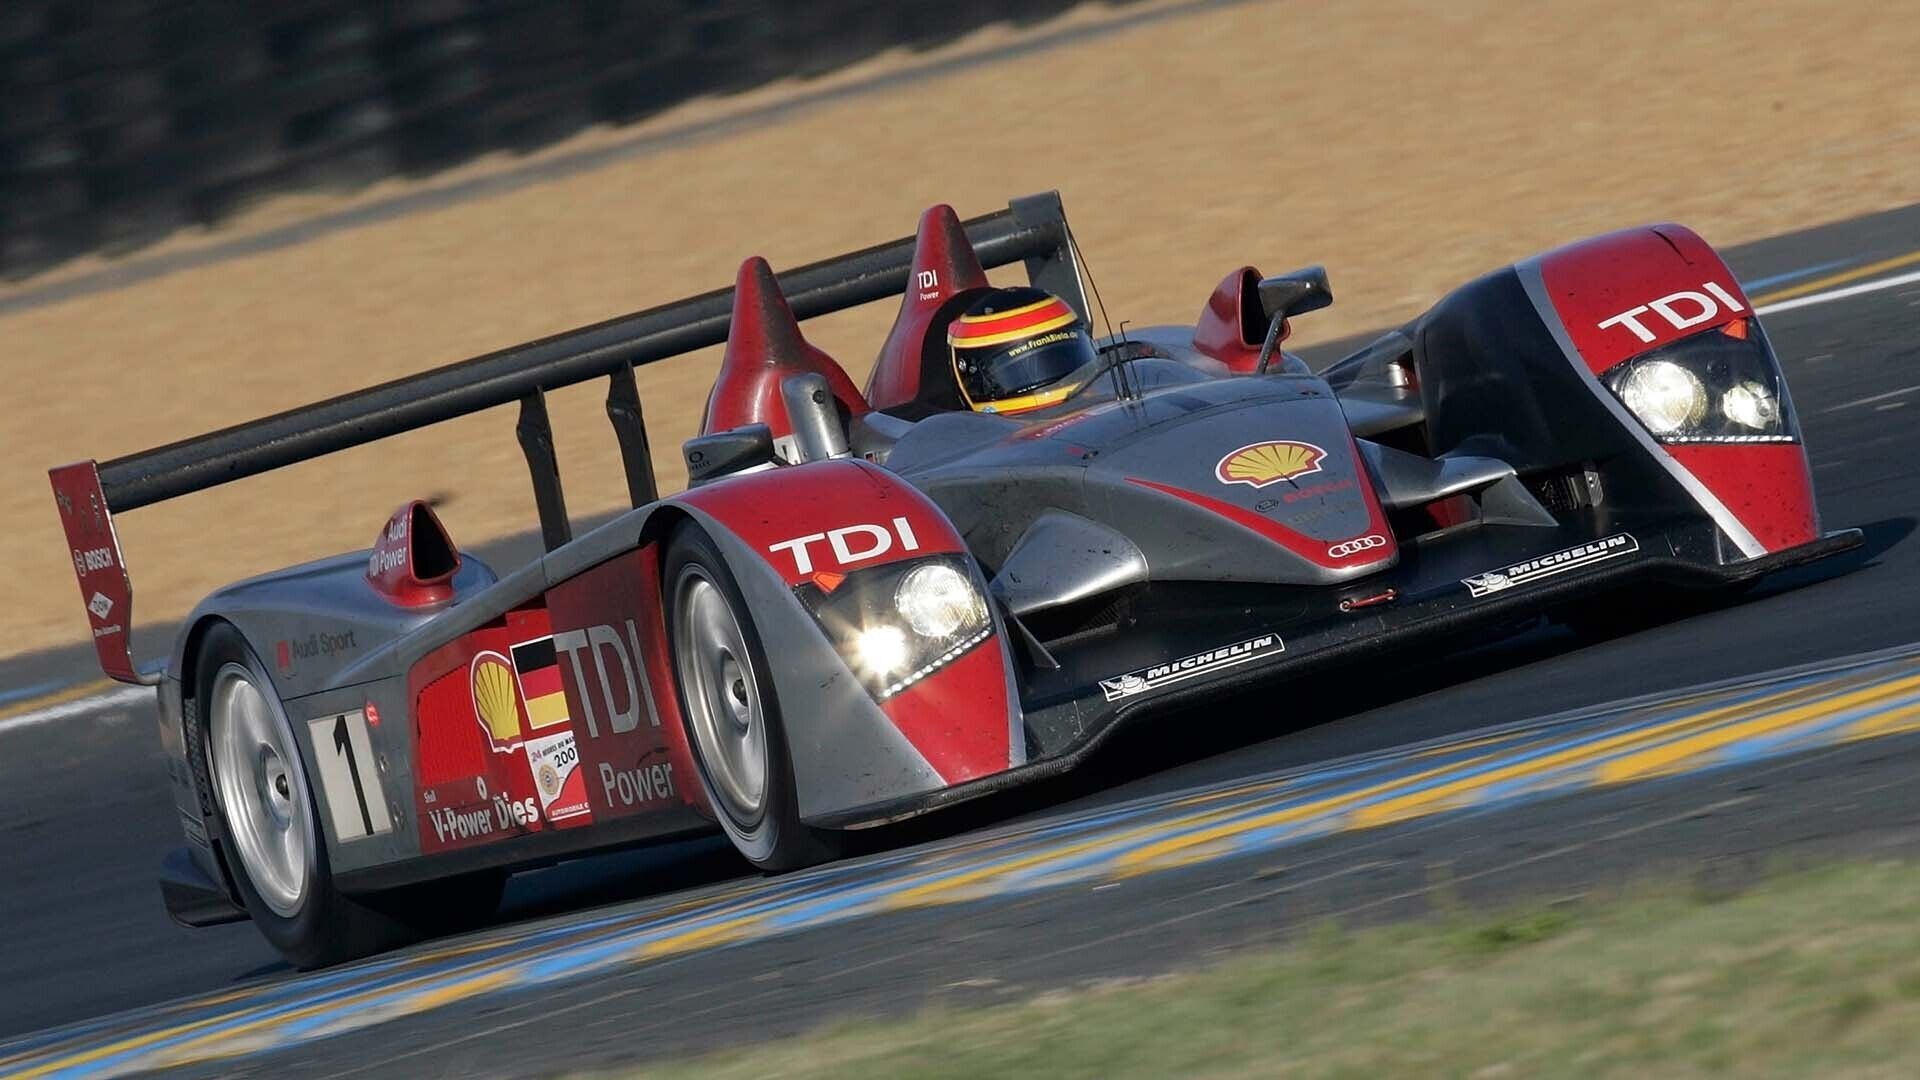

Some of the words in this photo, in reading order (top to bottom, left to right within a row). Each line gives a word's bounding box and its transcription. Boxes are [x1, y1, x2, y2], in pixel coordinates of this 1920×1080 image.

[918, 269, 938, 289] TDI
[1597, 281, 1745, 343] TDI
[388, 514, 407, 542] Audi
[769, 517, 920, 575] TDI
[84, 548, 114, 571] BOSCH
[379, 547, 407, 572] Power
[1507, 535, 1626, 576] MICHELIN
[292, 634, 319, 659] Audi
[320, 629, 357, 657] Sport
[1146, 635, 1275, 679] MICHELIN
[552, 619, 661, 739] TDI
[333, 715, 374, 836] 1
[598, 762, 673, 808] Power
[429, 808, 492, 843] V-Power
